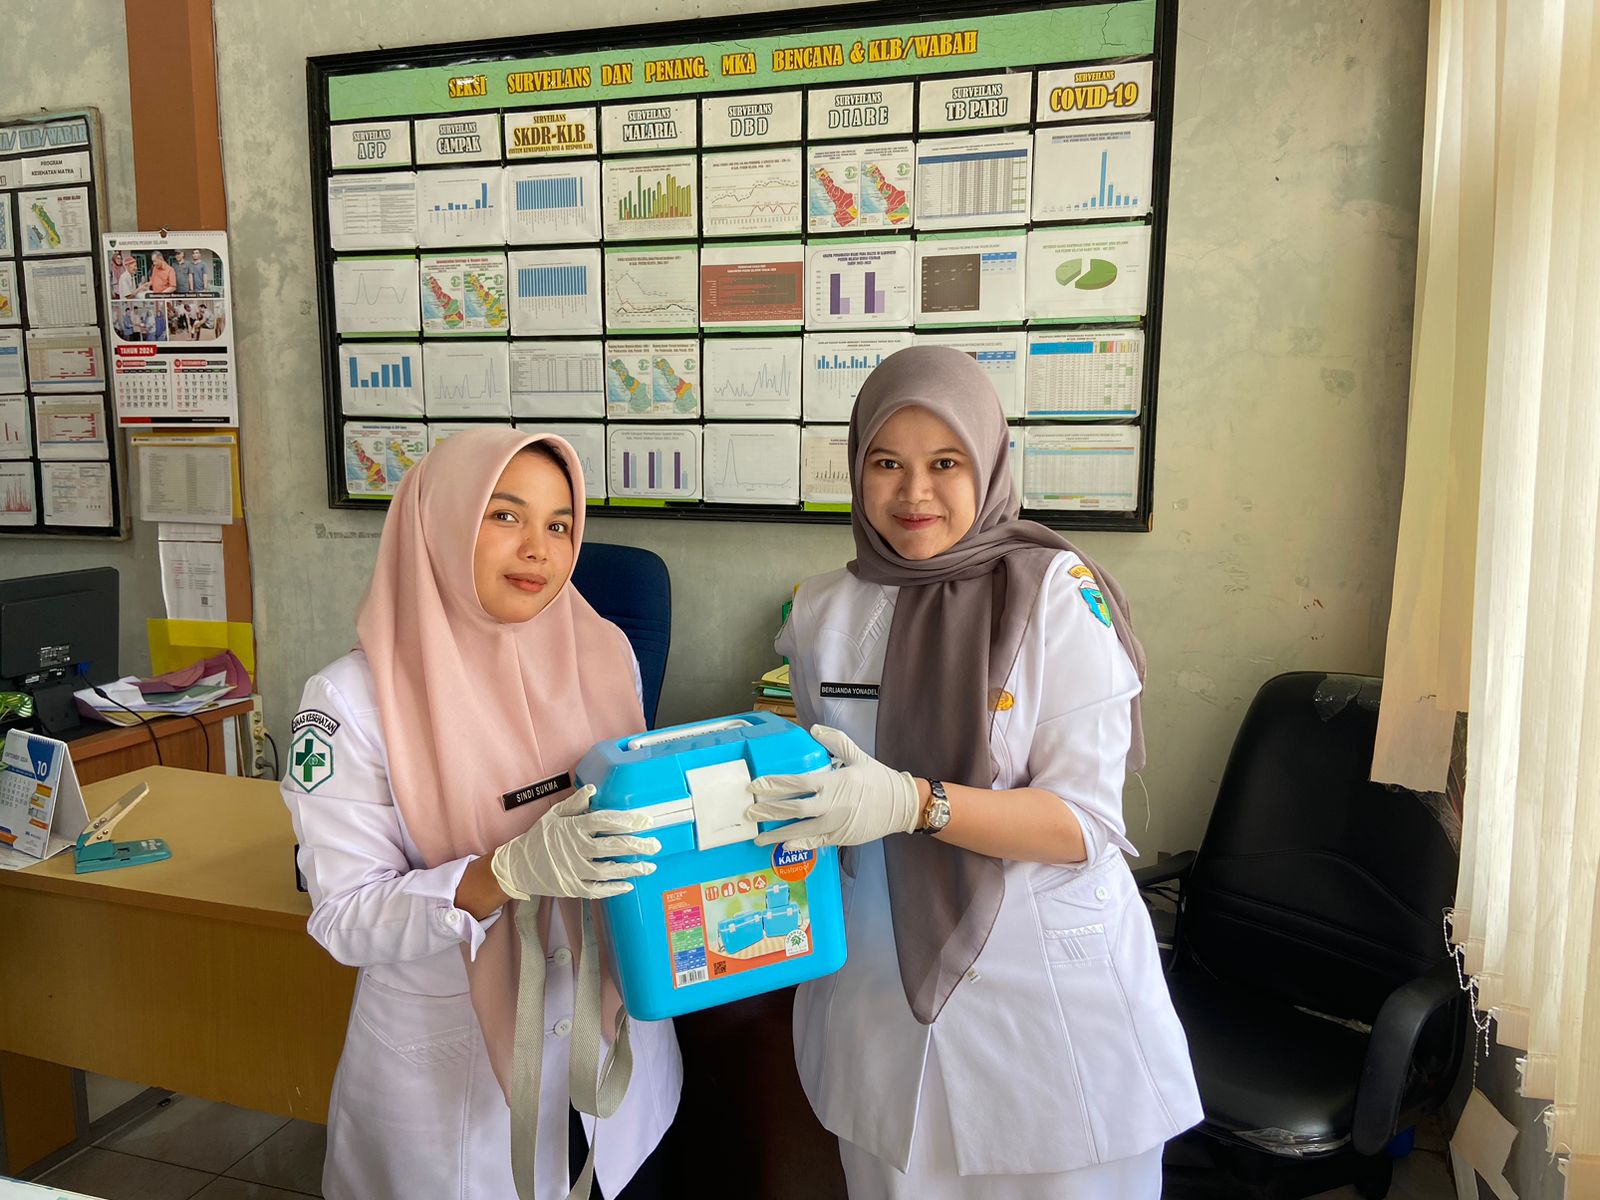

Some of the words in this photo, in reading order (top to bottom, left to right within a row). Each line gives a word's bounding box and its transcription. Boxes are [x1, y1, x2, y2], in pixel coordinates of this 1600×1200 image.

[449, 75, 488, 98] SEKSI
[508, 67, 591, 93] SURVEILANS
[601, 63, 633, 86] DAN
[645, 56, 709, 83] PENANG.
[721, 52, 757, 76] MKA
[772, 44, 844, 72] BENCANA
[850, 41, 865, 64] &
[868, 30, 978, 63] KLB/WABAH
[1075, 71, 1115, 83] SURVEILANS
[835, 92, 882, 107] SURVEILANS
[952, 83, 1003, 99] SURVEILANS
[1050, 81, 1139, 113] COVID-19
[628, 107, 671, 121] SURVEILANS
[728, 103, 773, 117] SURVEILANS
[828, 106, 889, 129] DIARE
[946, 101, 966, 121] TB
[969, 97, 1007, 119] PARU
[533, 114, 566, 124] SURVEILANS
[730, 117, 768, 137] DBD
[353, 129, 391, 142] SURVEILANS
[439, 122, 477, 136] SURVEILANS
[514, 124, 585, 146] SKDR-KLB
[623, 121, 677, 142] MALARIA
[437, 135, 482, 155] CAMPAK
[821, 685, 852, 695] BERLIANDA
[306, 713, 336, 733] KESEHATAN
[37, 760, 47, 777] 10
[516, 788, 535, 803] SINDI
[535, 780, 559, 796] SUKMA
[778, 852, 808, 865] KARAT
